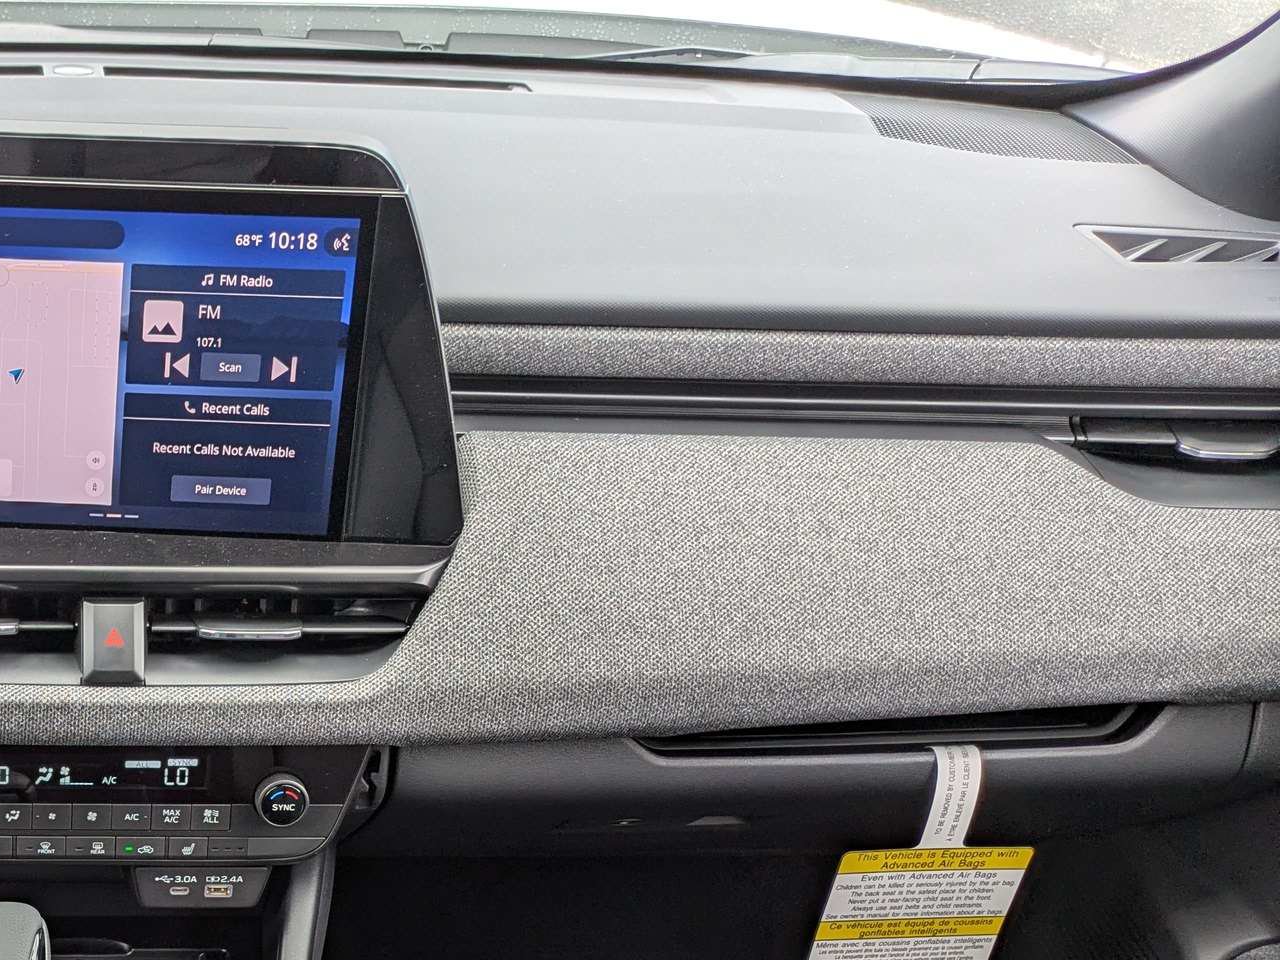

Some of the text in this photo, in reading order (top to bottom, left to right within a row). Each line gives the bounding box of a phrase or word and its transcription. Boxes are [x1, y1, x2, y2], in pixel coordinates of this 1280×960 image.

[269, 232, 318, 250] 10:18
[220, 274, 273, 288] FM Radio
[198, 304, 221, 319] FM
[196, 337, 222, 348] 107.1
[219, 362, 242, 373] Scan
[201, 402, 270, 416] Recent Calls
[152, 442, 296, 458] Recent Calls Not Available
[195, 485, 247, 496] Pair Device
[102, 776, 118, 785] A/C
[272, 803, 296, 811] SYNC
[124, 813, 140, 821] A/C
[857, 849, 1020, 861] This Vehicle is Equipped with
[880, 859, 986, 870] Advanced Air Bags
[174, 875, 244, 883] 3.0A 2.4A
[908, 871, 955, 880] Advanced
[957, 871, 970, 879] Air
[974, 871, 998, 879] Bags
[829, 922, 842, 930] Ce
[886, 920, 901, 928] est
[904, 919, 935, 928] équipé
[953, 918, 993, 926] coussins
[859, 927, 957, 937] gonflables intelligents
[878, 939, 910, 947] coussins
[913, 938, 951, 946] gonflables
[953, 936, 993, 944] intelligents
